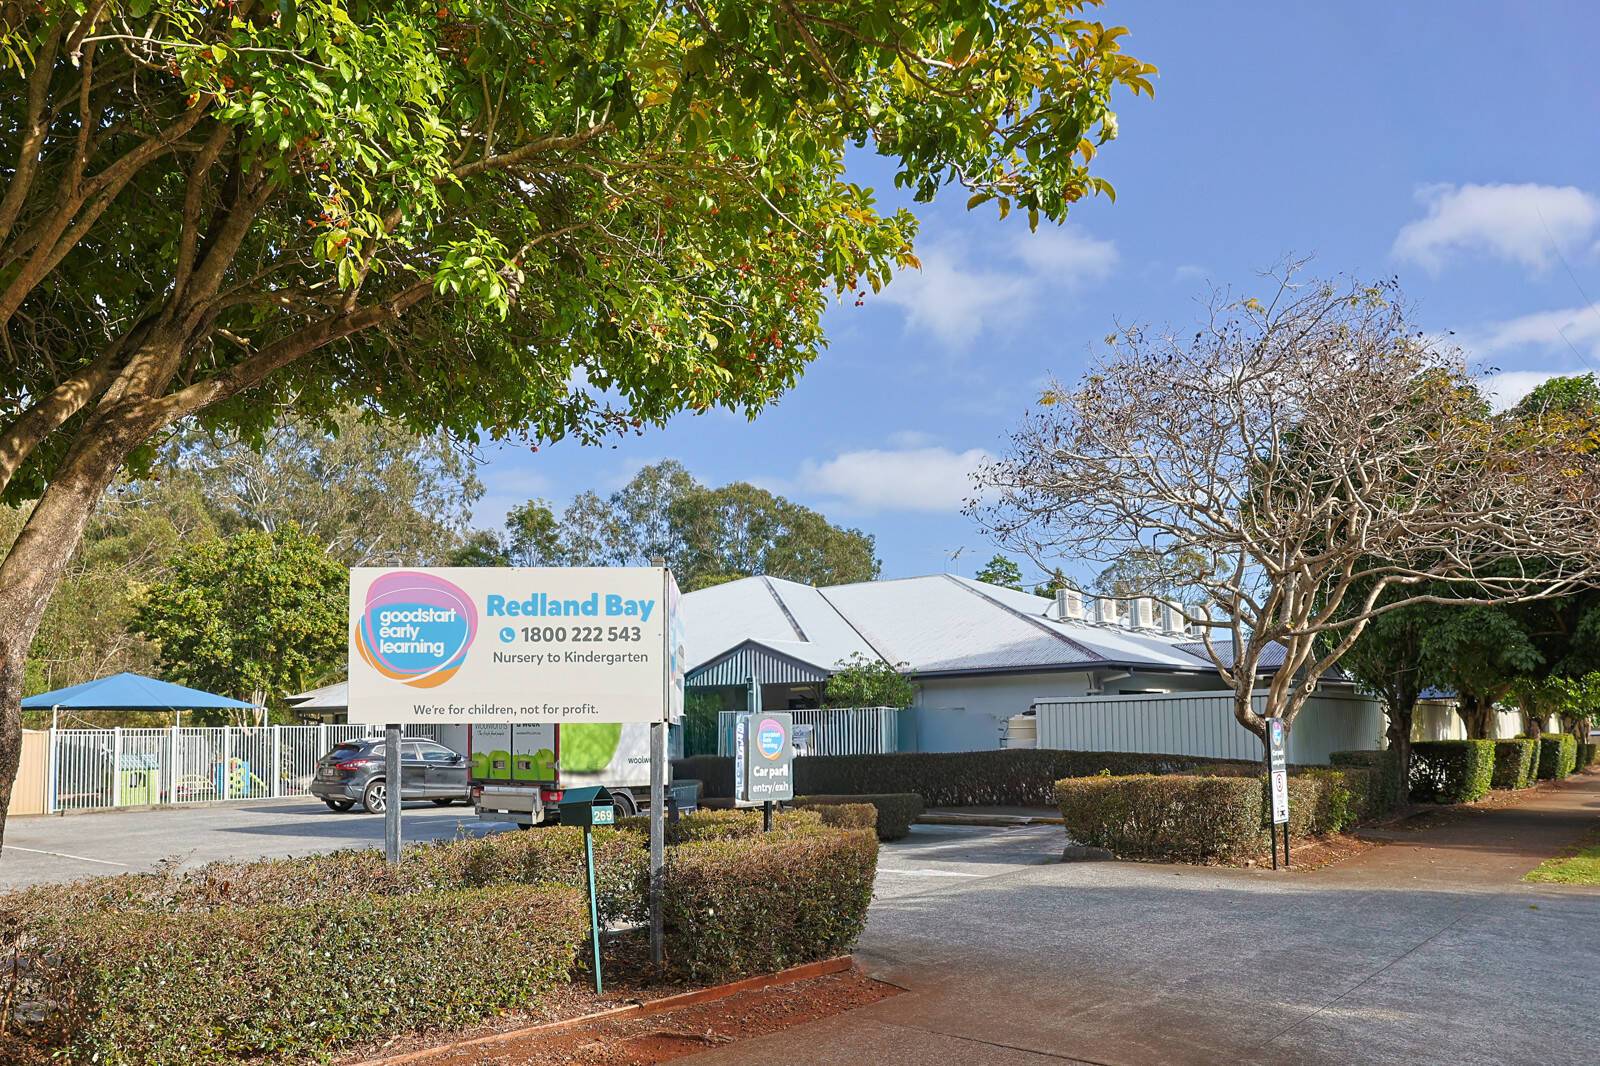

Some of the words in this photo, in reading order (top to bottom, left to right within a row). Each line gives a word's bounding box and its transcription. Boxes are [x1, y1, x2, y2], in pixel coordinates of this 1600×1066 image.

[487, 592, 598, 616] Redland
[605, 594, 655, 622] Bay
[379, 608, 456, 625] goodstart
[379, 624, 420, 640] early
[521, 627, 566, 642] 1800
[572, 627, 602, 642] 222
[608, 627, 641, 641] 543
[379, 639, 444, 657] learning
[493, 651, 544, 666] Nursery
[547, 653, 560, 662] to
[565, 651, 648, 665] Kindergarten
[448, 704, 465, 714] for
[468, 704, 516, 716] children,
[521, 705, 539, 714] not
[543, 704, 559, 714] for
[563, 704, 598, 716] profit.
[754, 766, 768, 777] Car
[594, 810, 612, 821] 269
